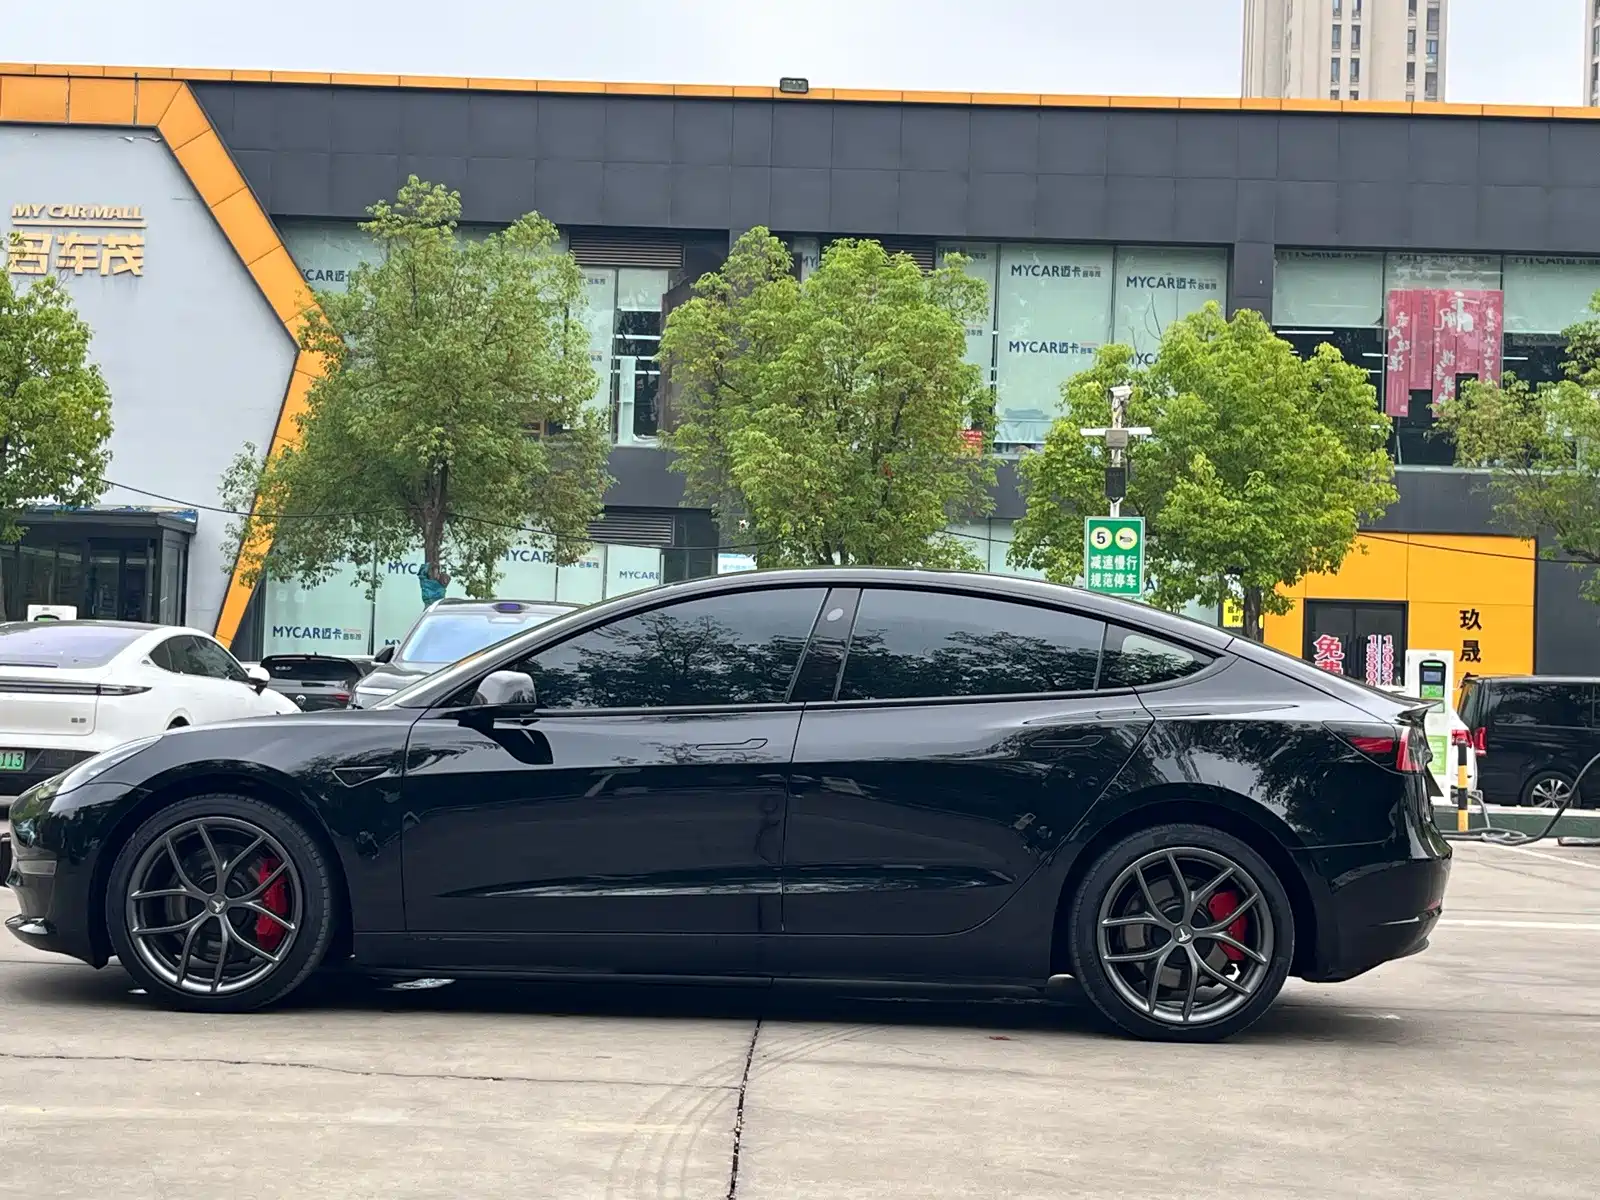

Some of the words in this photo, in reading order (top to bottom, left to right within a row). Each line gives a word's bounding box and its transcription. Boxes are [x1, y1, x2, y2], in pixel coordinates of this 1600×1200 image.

[12, 203, 45, 218] MY
[48, 203, 90, 219] CAR
[89, 205, 144, 220] MALL
[1096, 531, 1106, 545] 5
[1090, 555, 1138, 571] 减速慢行
[1090, 572, 1137, 589] 规范停车
